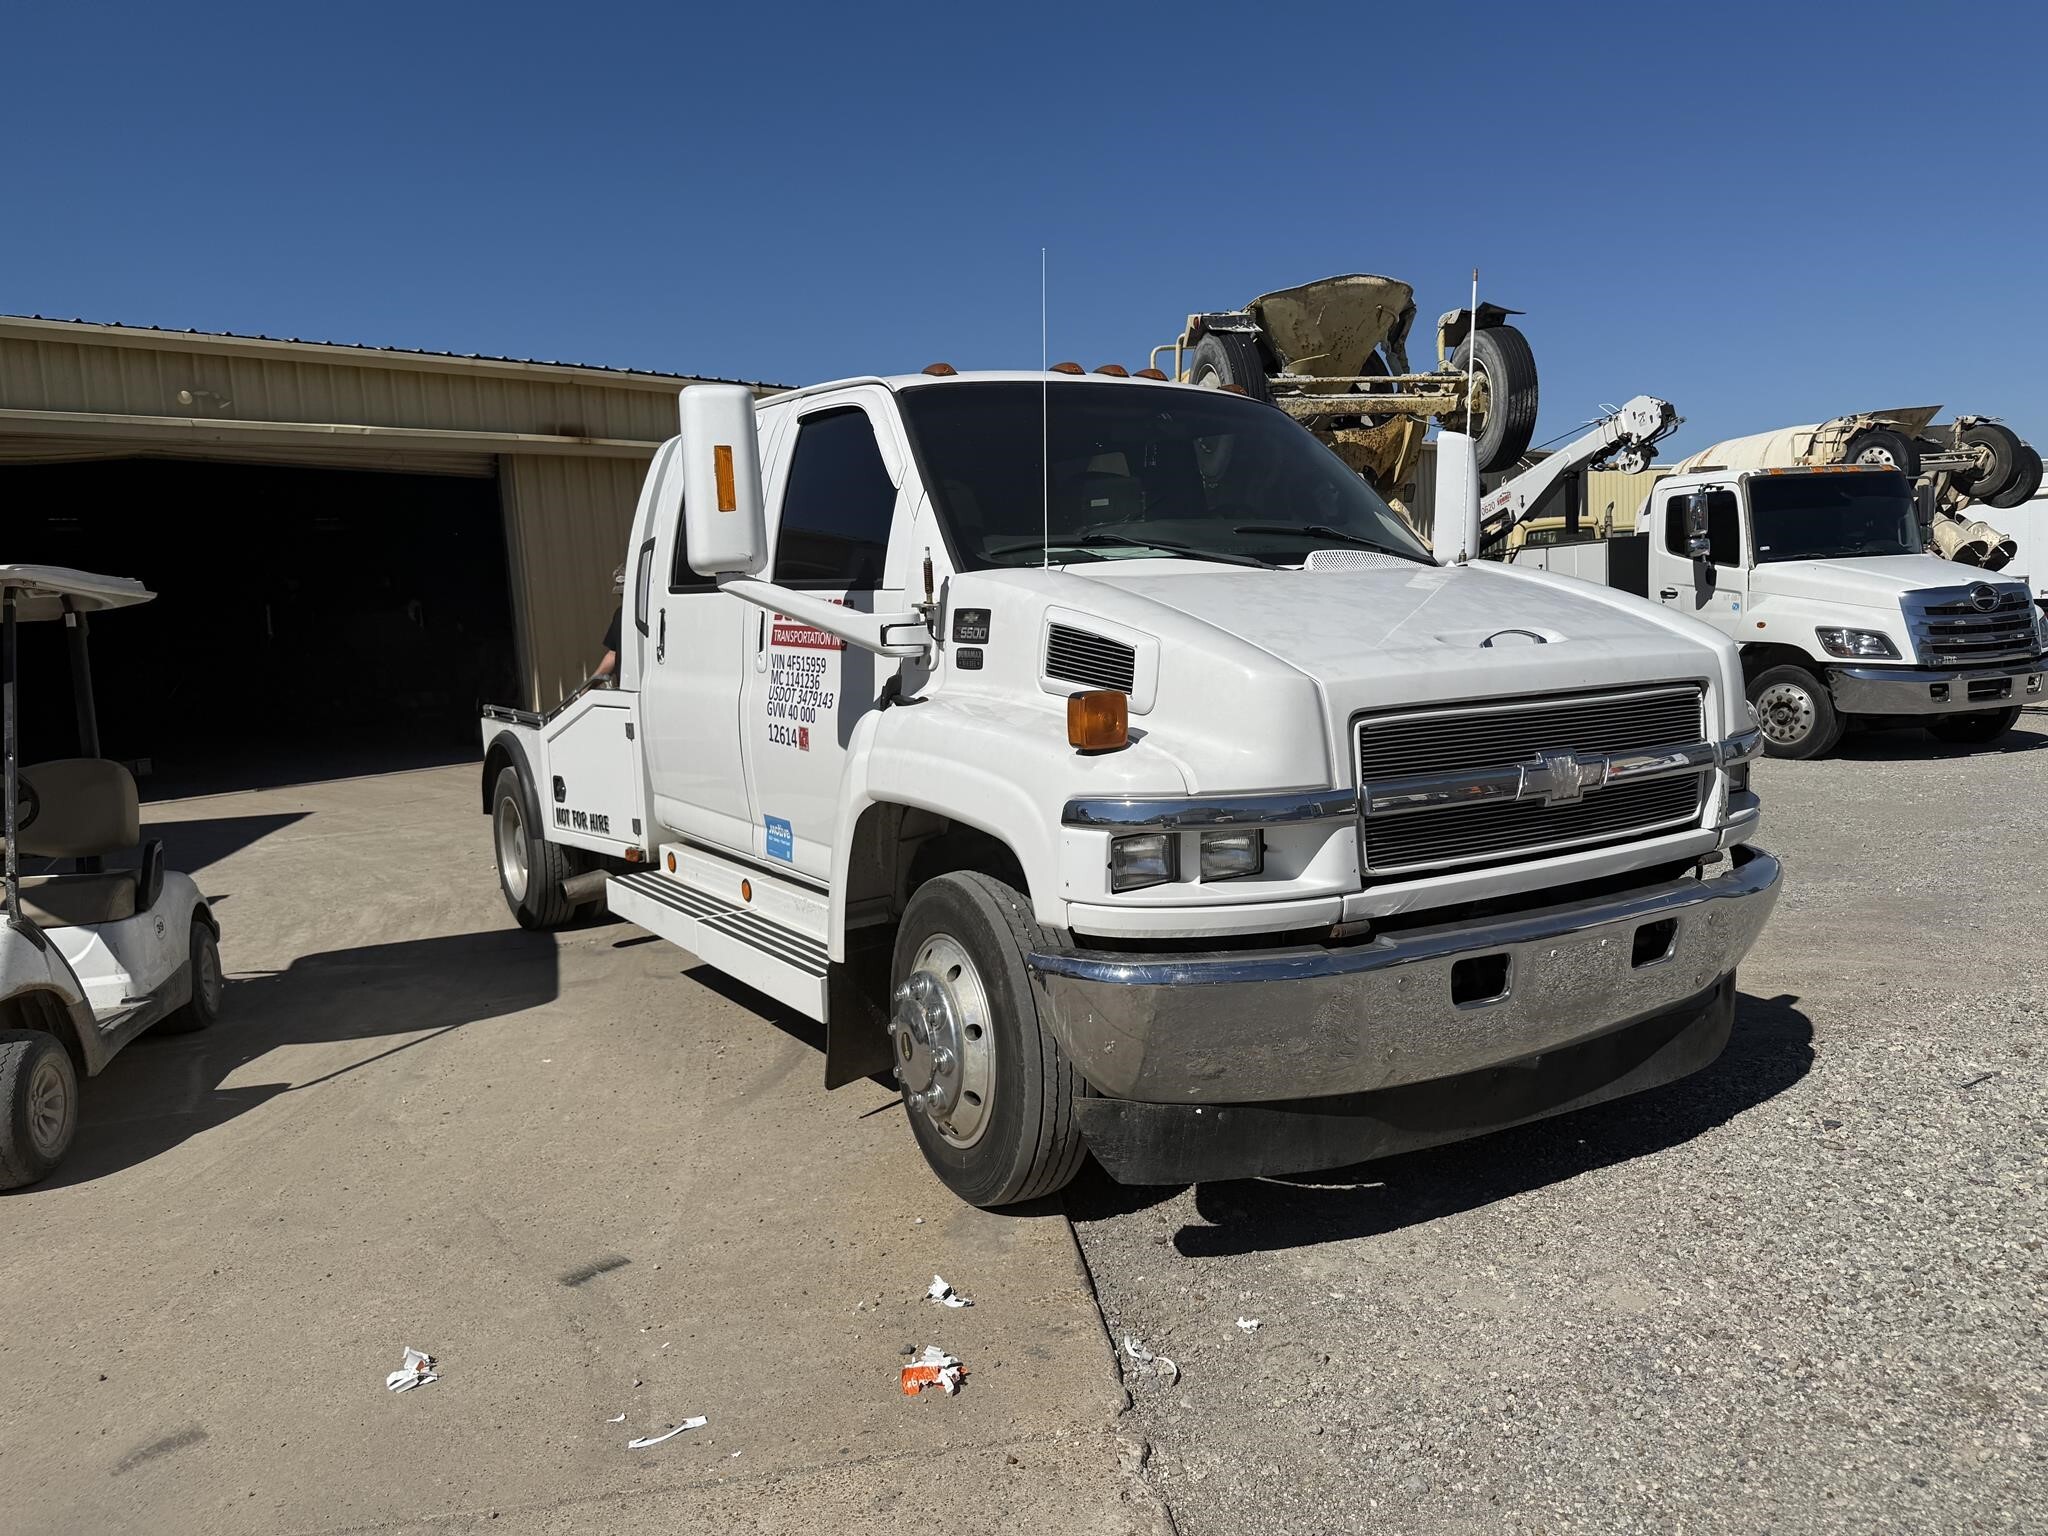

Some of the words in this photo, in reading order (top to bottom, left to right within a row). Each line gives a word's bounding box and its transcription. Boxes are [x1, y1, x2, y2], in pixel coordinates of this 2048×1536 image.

[773, 629, 835, 646] TRANSPORTATION
[771, 653, 785, 670] VIN
[787, 655, 826, 674] 4F515959
[770, 670, 784, 686] MC
[785, 671, 820, 690] 1141236
[768, 686, 798, 703] USDOT
[797, 689, 834, 709] 3479143
[767, 701, 787, 718] GVW
[788, 704, 798, 720] 40
[800, 706, 816, 723] 000
[768, 723, 797, 748] 12614
[555, 807, 571, 828] NOT
[571, 810, 589, 831] FOR
[589, 813, 610, 835] HIRE
